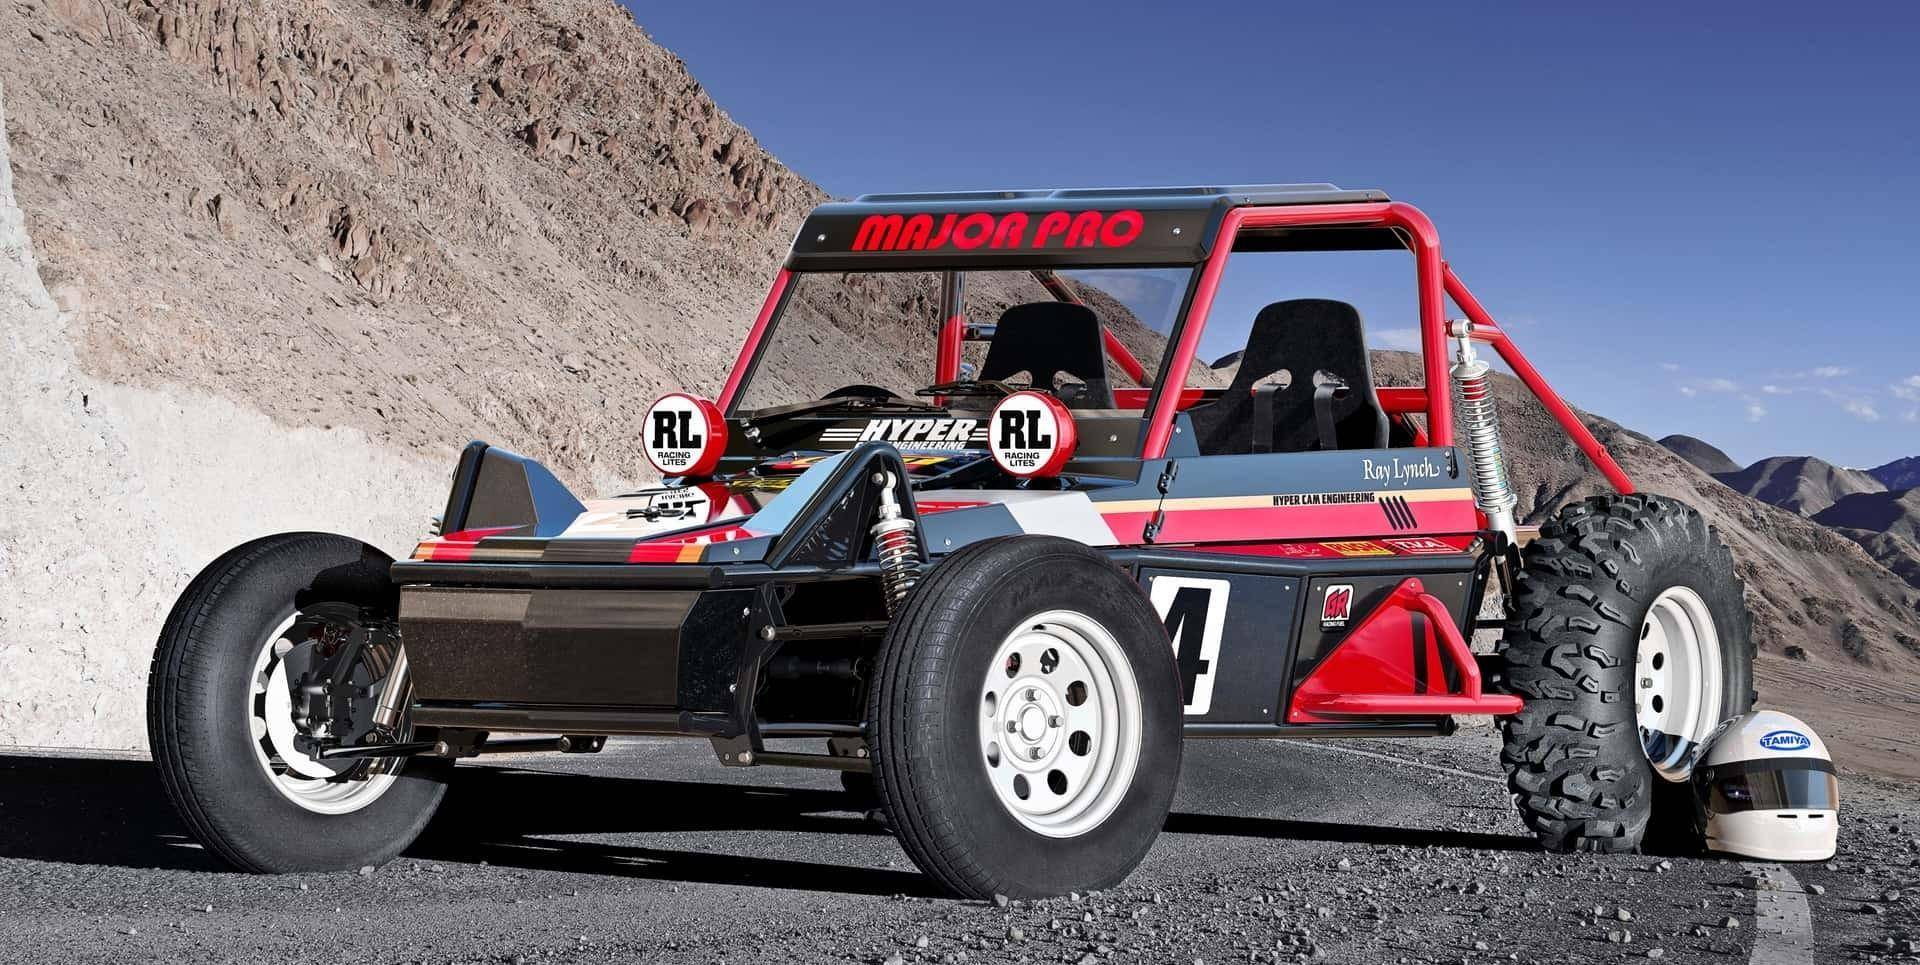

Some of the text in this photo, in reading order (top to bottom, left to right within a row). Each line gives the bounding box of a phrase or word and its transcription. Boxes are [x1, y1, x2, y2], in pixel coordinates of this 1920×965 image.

[852, 210, 1145, 251] MAJOR PRO
[652, 410, 702, 449] RL
[858, 418, 978, 442] HYPER
[999, 409, 1052, 449] RL
[887, 441, 967, 451] NGINEERING
[657, 451, 691, 459] RACING
[662, 458, 687, 466] LITES
[1004, 452, 1040, 460] RACING
[1009, 459, 1036, 467] LITES
[1362, 456, 1440, 486] Ray Lynch
[1272, 492, 1375, 506] HYPER CAM ENGINEERING
[1164, 586, 1212, 706] 4
[1763, 736, 1808, 745] TAMIYA
